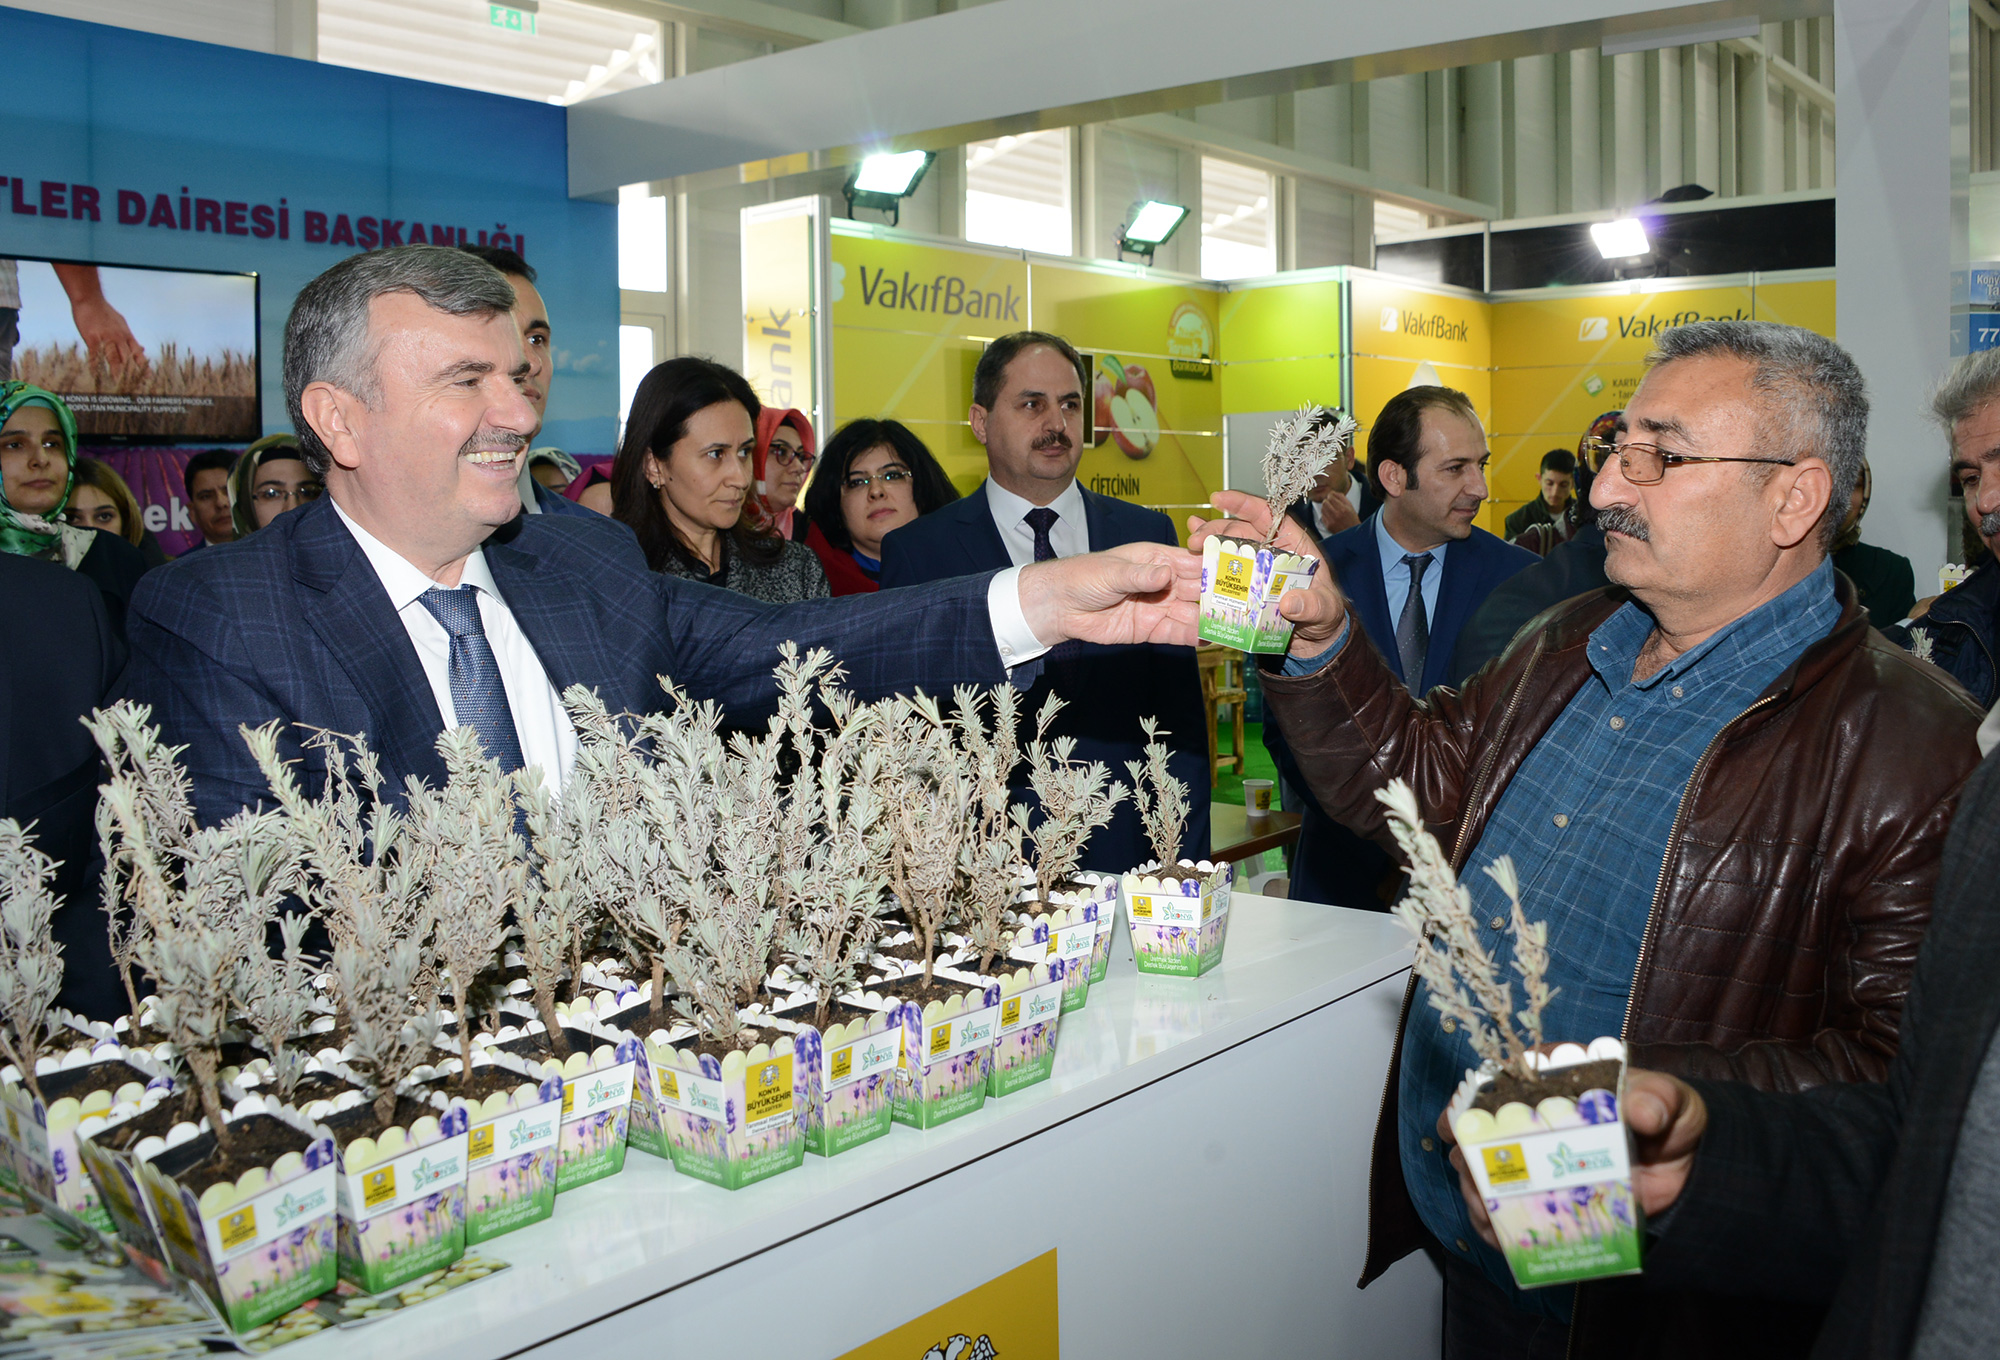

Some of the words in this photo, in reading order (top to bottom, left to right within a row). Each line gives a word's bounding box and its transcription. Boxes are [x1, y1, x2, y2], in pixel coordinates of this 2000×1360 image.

[117, 186, 289, 240] DAİRESİ
[859, 265, 1021, 323] VakıfBank
[1402, 310, 1468, 343] VakıfBank
[758, 1086, 781, 1098] KONYA
